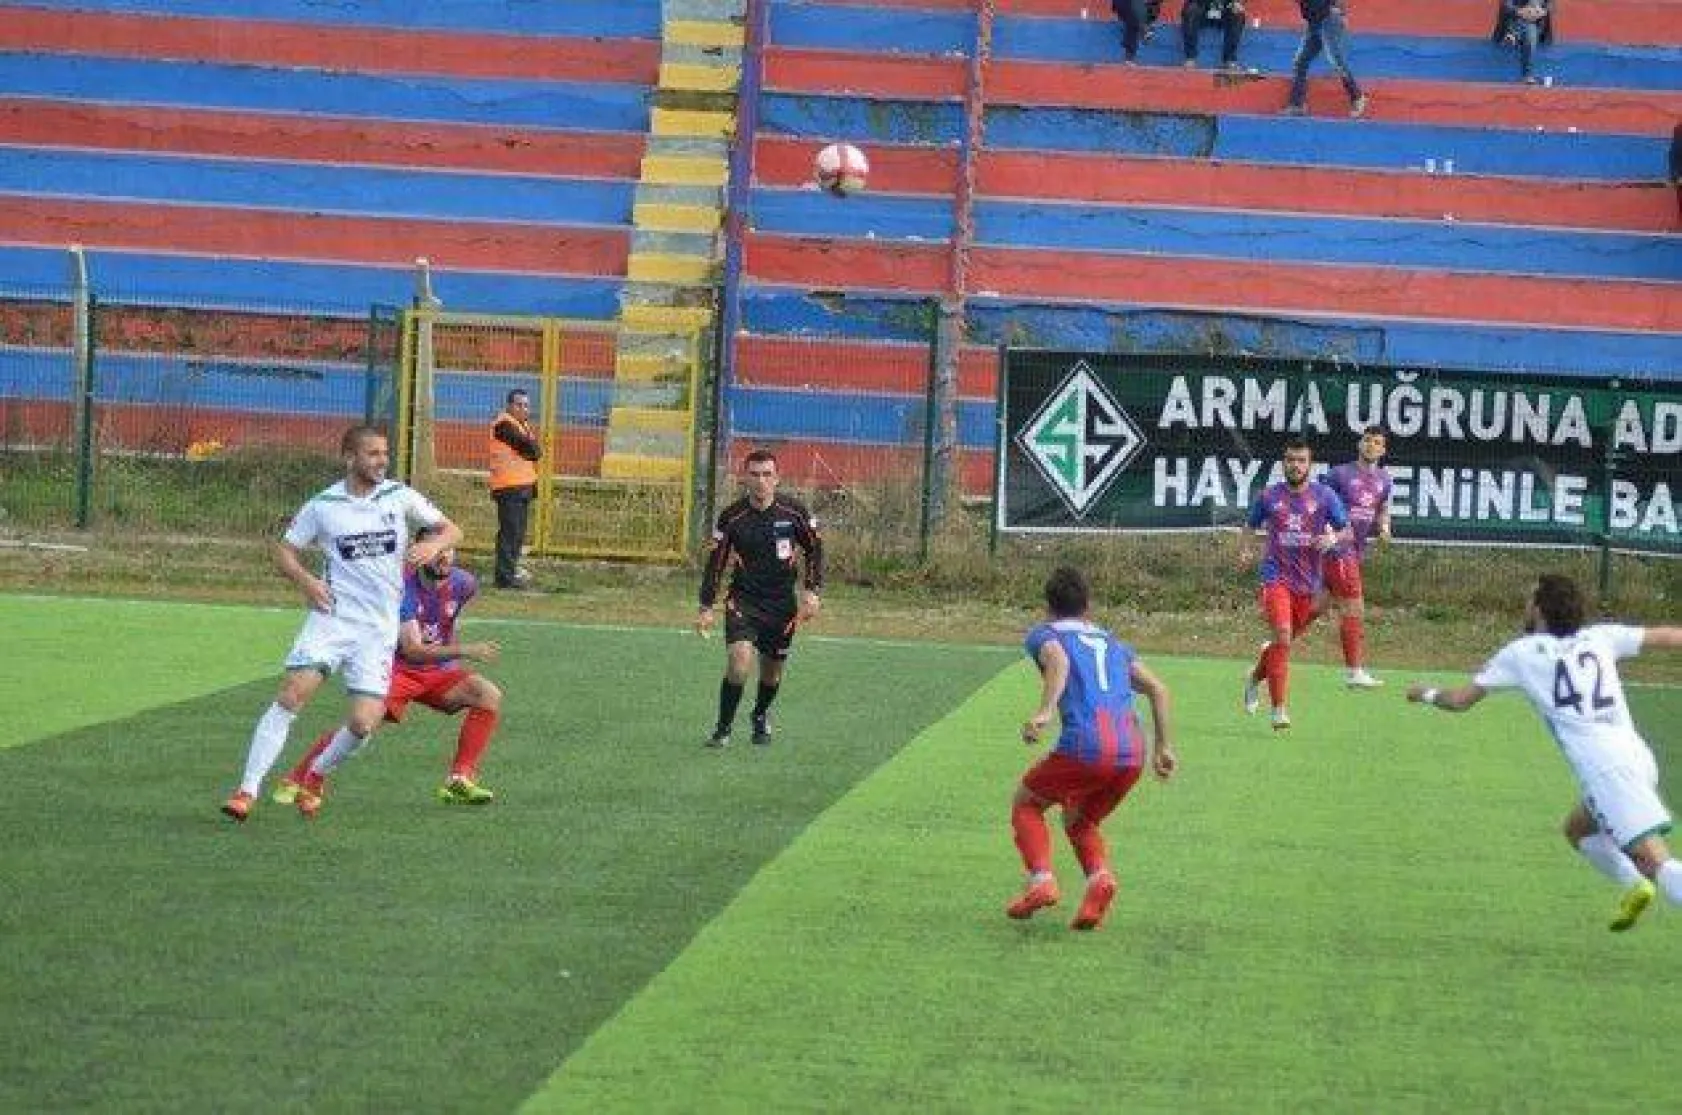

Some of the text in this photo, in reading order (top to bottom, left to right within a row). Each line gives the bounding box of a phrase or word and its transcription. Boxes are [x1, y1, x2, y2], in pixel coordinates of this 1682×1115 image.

[1157, 375, 1330, 433] ARMA
[1346, 371, 1593, 448] UĞRUNA
[1153, 455, 1331, 509] HAY
[1078, 633, 1108, 692] 7
[1554, 651, 1615, 715] 42
